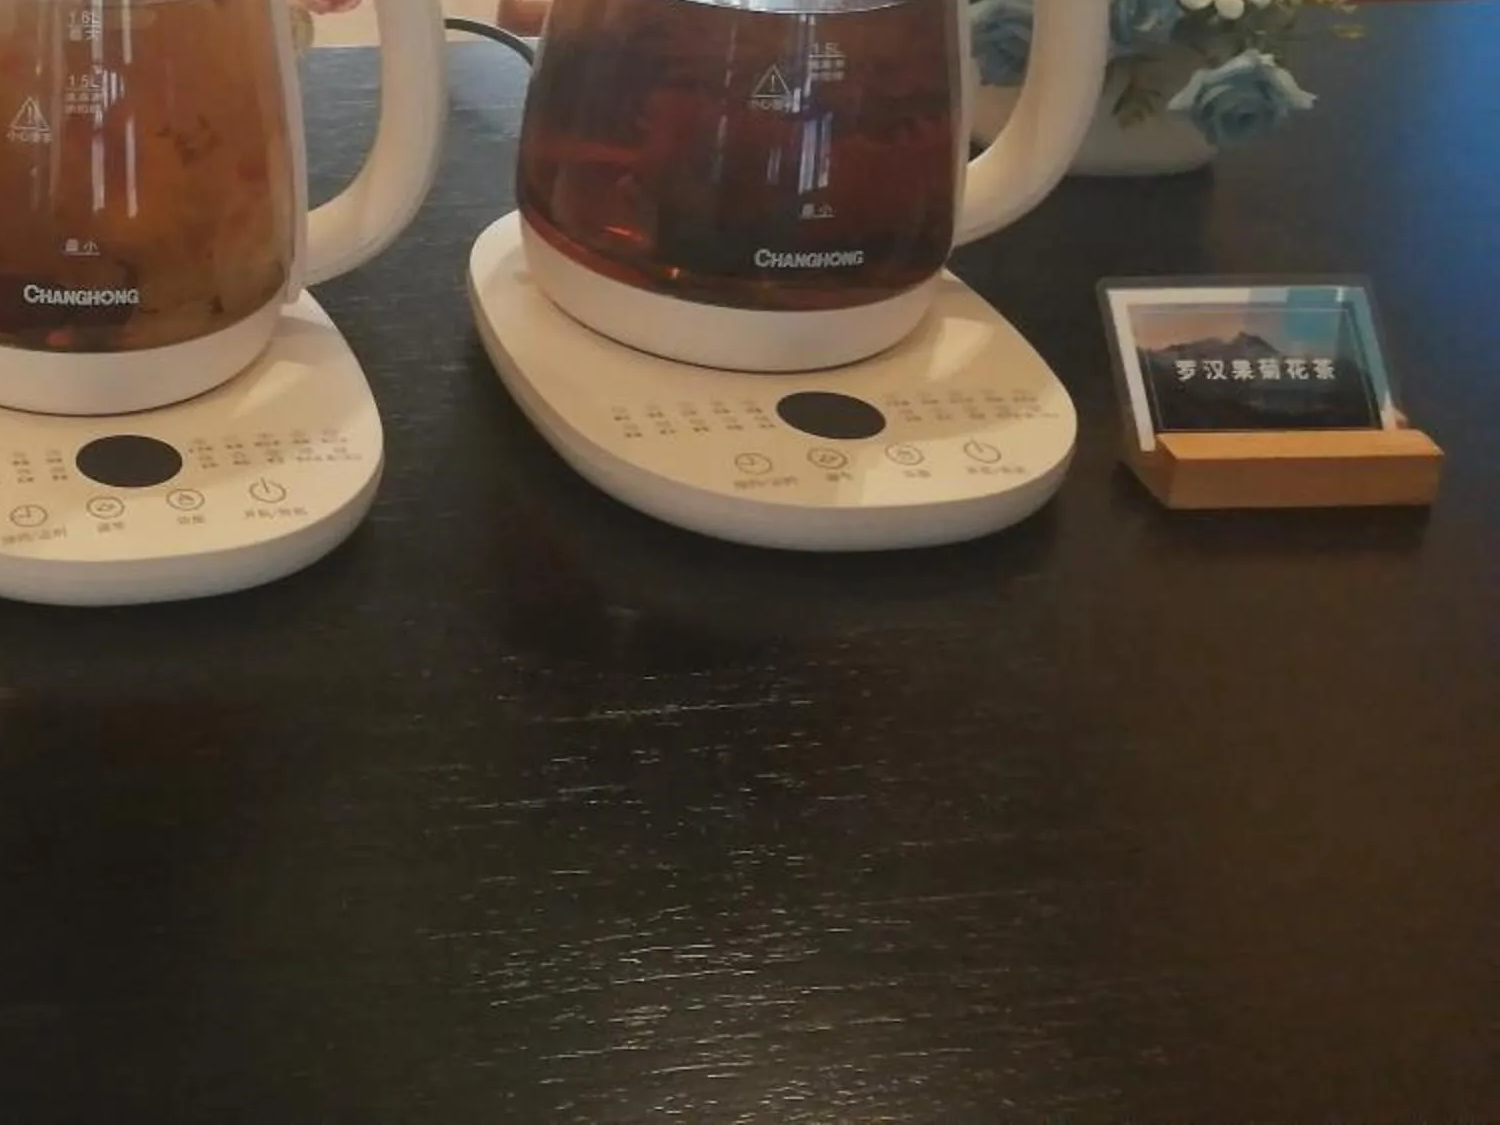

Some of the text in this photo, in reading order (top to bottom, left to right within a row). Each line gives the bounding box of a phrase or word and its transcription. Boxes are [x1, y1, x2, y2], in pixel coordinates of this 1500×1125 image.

[754, 248, 864, 268] CHANGHONG
[23, 284, 140, 306] CHANGHONG
[1174, 357, 1335, 381] 罗汉果菊花茶
